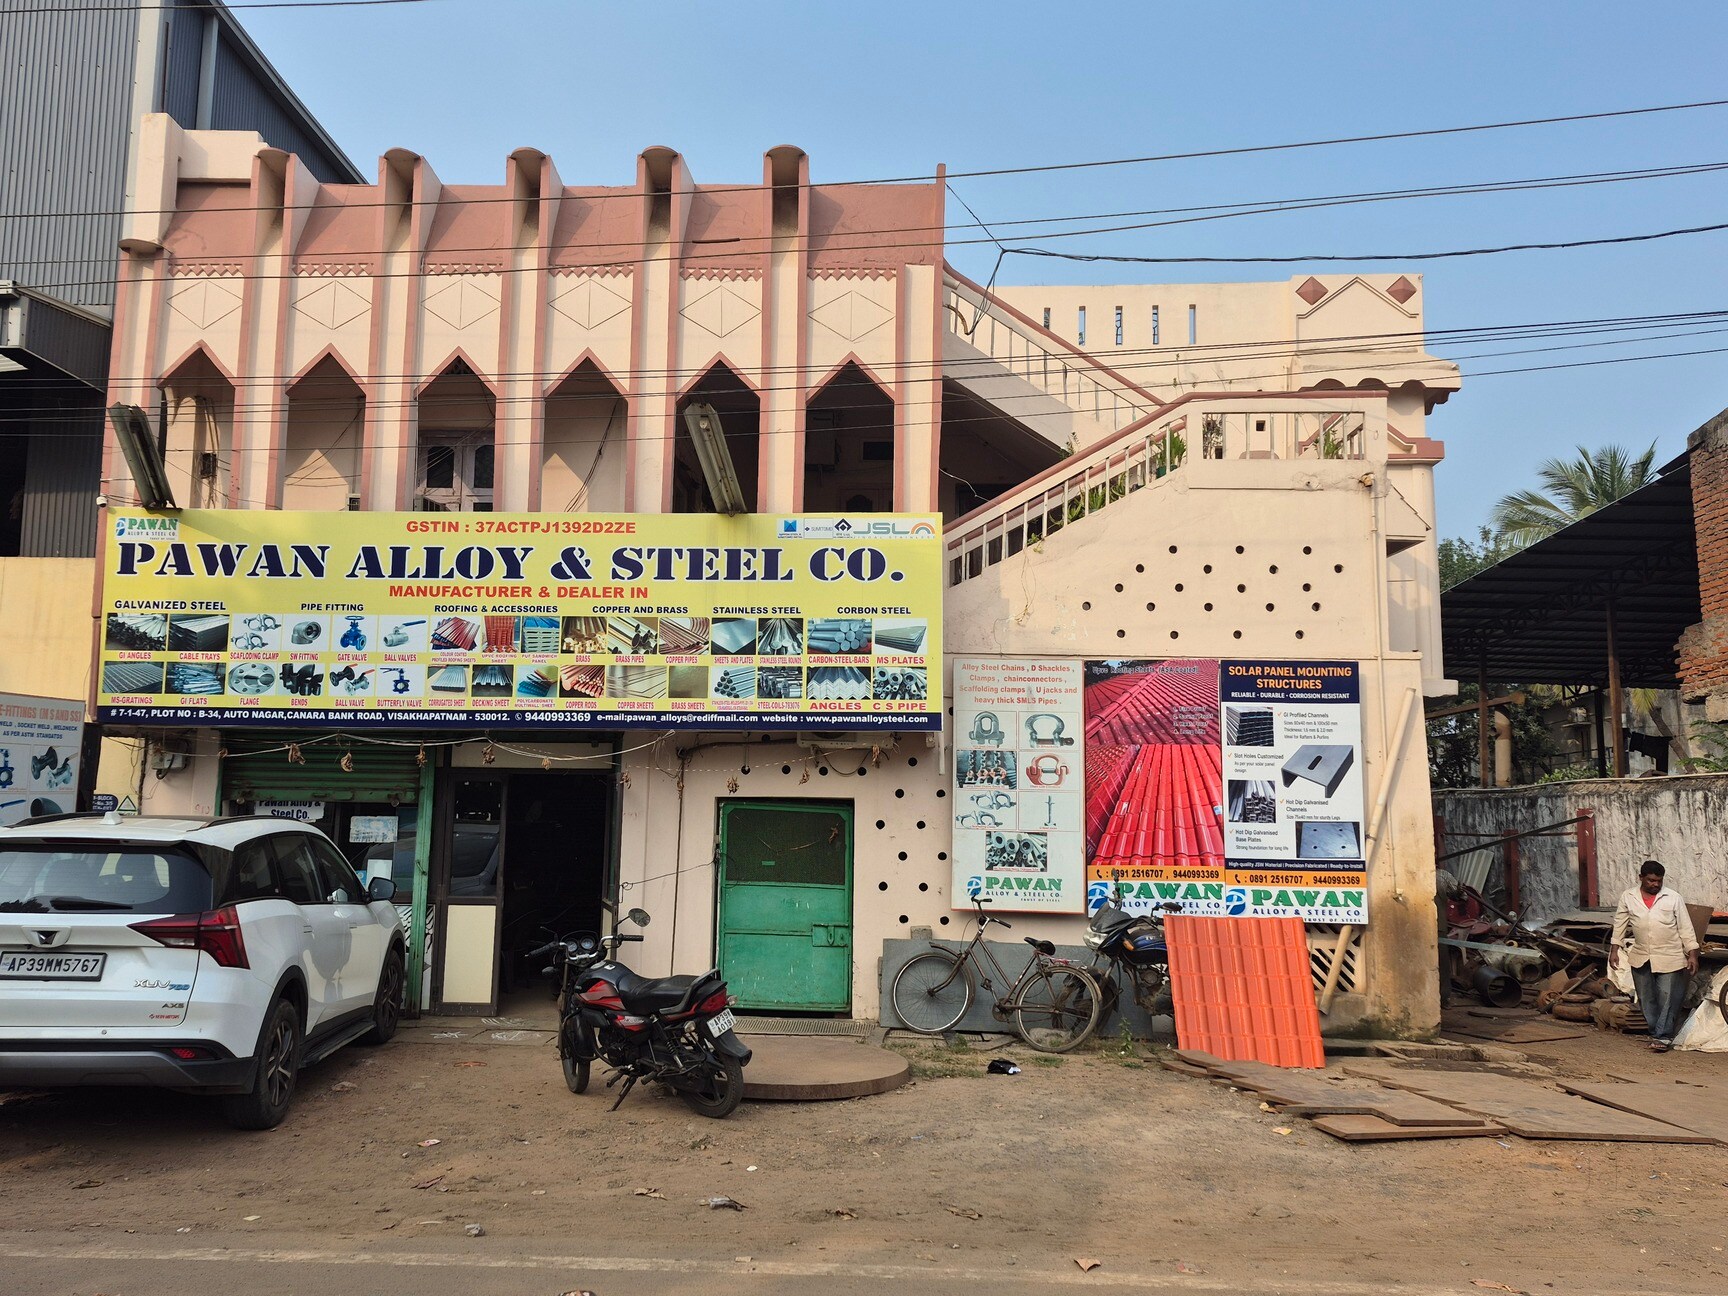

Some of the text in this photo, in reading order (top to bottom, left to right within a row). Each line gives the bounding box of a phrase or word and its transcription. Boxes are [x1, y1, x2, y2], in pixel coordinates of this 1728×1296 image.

[127, 518, 178, 530] PAWAN
[406, 521, 636, 534] GSTIN 37ACTPJ1392D2ZE
[853, 522, 910, 535] JSL
[116, 542, 904, 581] PAWAN ALLOY & STEEL CO.
[389, 585, 648, 599] MANUFACTURER & DEALER IN
[115, 600, 226, 610] GALVANIZED STEEL
[301, 603, 364, 611] PIPE FITTING
[434, 604, 478, 613] ROOFING
[491, 605, 558, 613] ACCESSORIES
[656, 606, 689, 614] BRASS
[837, 606, 878, 614] CORBON
[262, 652, 279, 660] CLAMP
[299, 653, 319, 661] FITTING
[337, 653, 367, 661] GATE VALVE
[384, 654, 417, 662] BALL VALVES
[615, 655, 645, 663] BRASS PIPES
[684, 656, 698, 664] PIPES
[714, 656, 729, 664] SHEETS
[739, 656, 754, 664] PLATES
[808, 656, 870, 664] CARBON-STEEL-BARS
[876, 656, 925, 664] MS PLATES
[1228, 666, 1352, 677] SOLAR PANEL MOUNTING
[969, 674, 996, 682] Clamps
[1256, 679, 1322, 689] STRUCTURES
[959, 685, 998, 693] Scaffolding
[1000, 686, 1026, 694] clamps
[1043, 686, 1063, 694] jacks
[111, 696, 153, 704] MS-GRATINGS
[180, 697, 208, 705] GI FLATS
[290, 698, 308, 706] BENDS
[335, 699, 365, 707] BALL VALVE
[377, 699, 422, 707] BUTTERFLY VALVE
[454, 699, 466, 707] SHEET
[472, 699, 510, 707] DECKING SHEET
[974, 696, 995, 704] heavy
[1038, 697, 1058, 705] Pipes
[565, 701, 597, 709] COPPER RODS
[617, 701, 654, 709] COPPER SHEETS
[671, 702, 686, 710] BRASS
[687, 702, 705, 710] SHEETS
[810, 702, 862, 710] ANGLES
[873, 702, 927, 710] C S PIPE
[119, 709, 149, 718] 7-1-47,
[177, 710, 191, 718] NO
[199, 710, 221, 719] B-34,
[328, 711, 354, 720] BANK
[356, 712, 385, 721] ROAD,
[387, 712, 467, 720] VISAKHAPATNAM
[474, 712, 511, 721] 530012.
[524, 712, 591, 722] 9440993369
[762, 713, 798, 722] website
[806, 714, 928, 724] www.pawanalloysteel.com
[270, 809, 310, 820] Steel Co.
[1131, 869, 1219, 879] 2516707 9440993369
[985, 876, 1062, 891] PAWAN
[1249, 875, 1360, 885] 0891 2516707 9440993369
[1113, 882, 1224, 900] PAWAN
[1250, 889, 1364, 908] PAWAN
[7, 957, 100, 973] AP39MM5767
[133, 979, 170, 988] XUV
